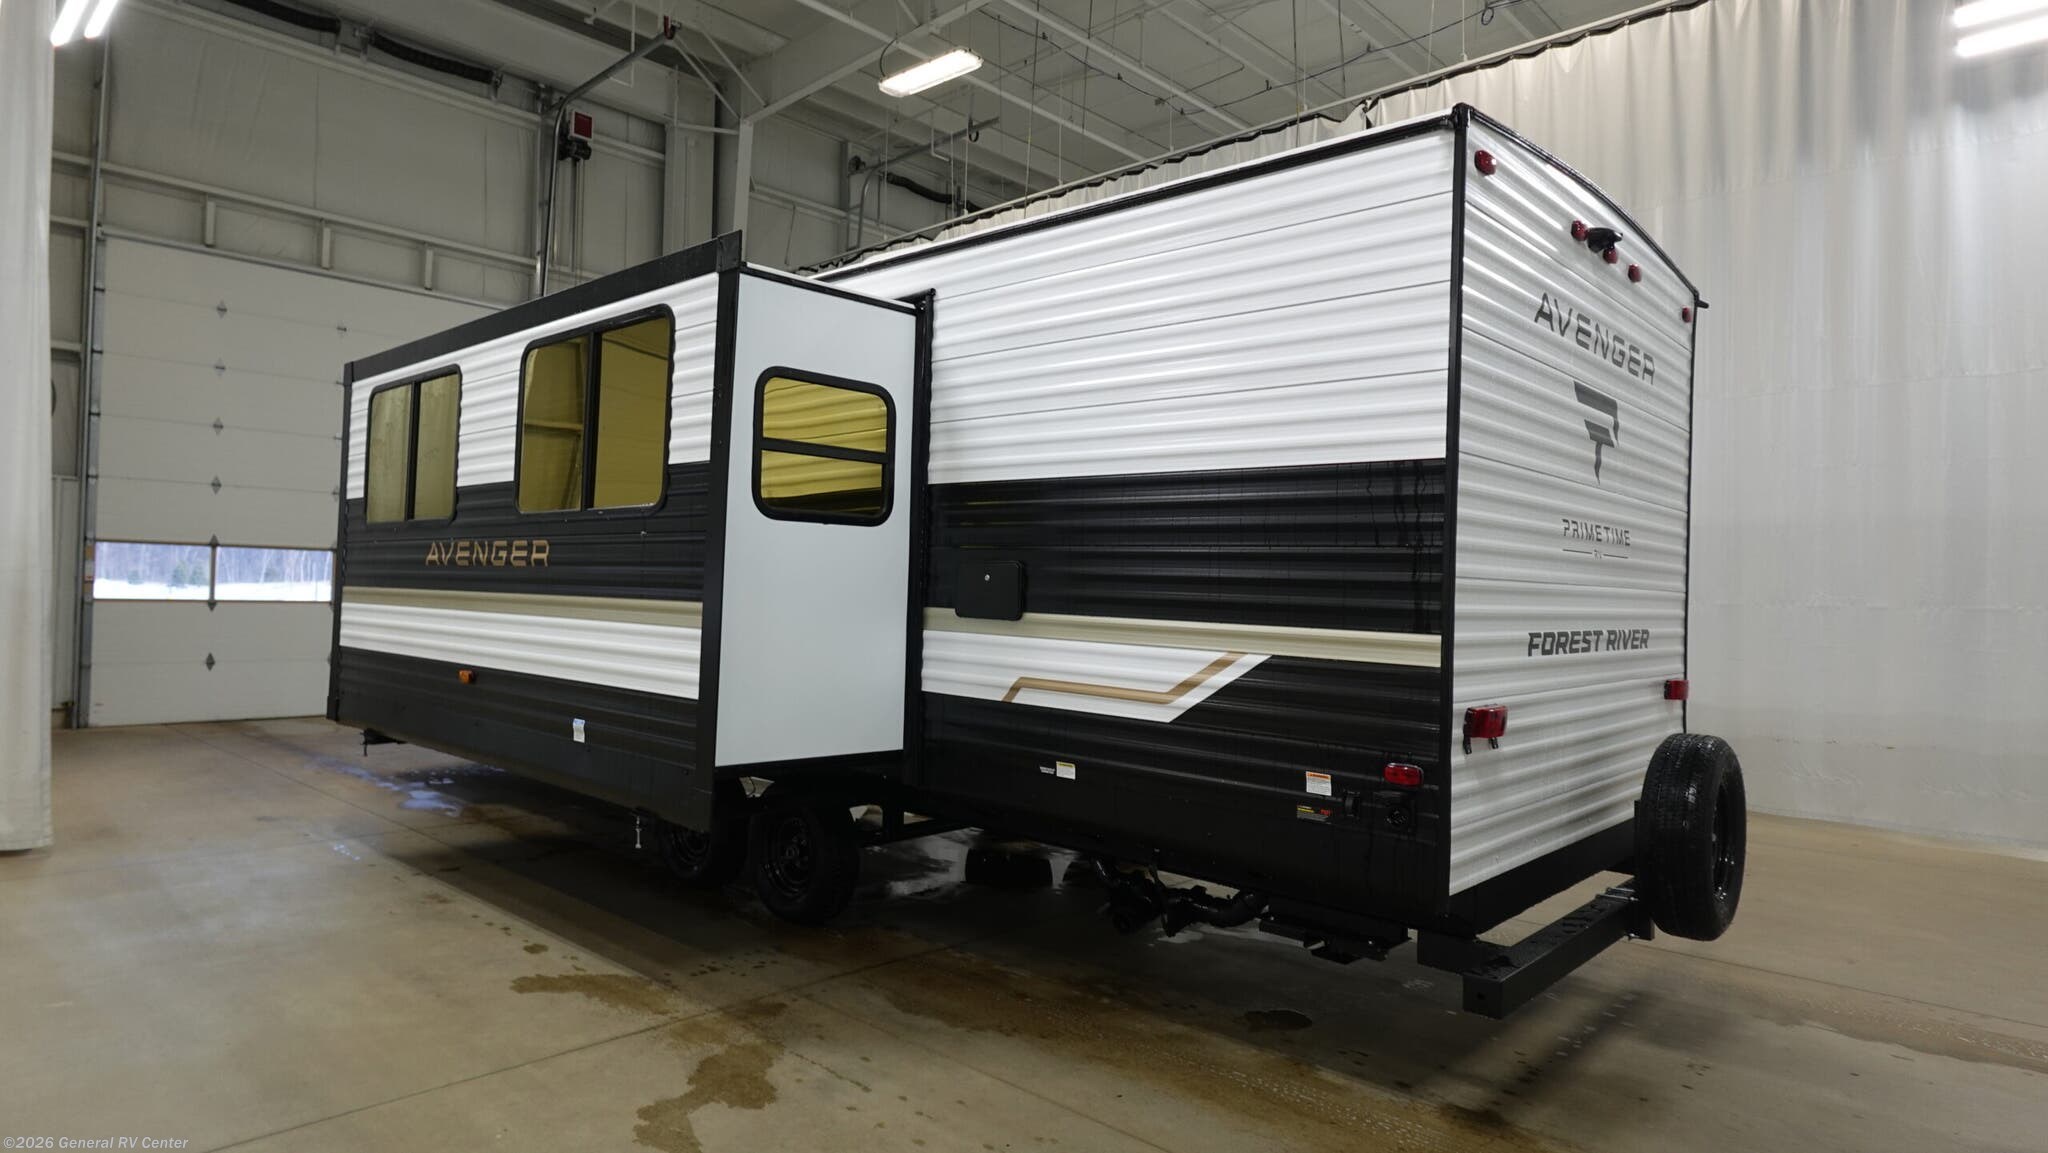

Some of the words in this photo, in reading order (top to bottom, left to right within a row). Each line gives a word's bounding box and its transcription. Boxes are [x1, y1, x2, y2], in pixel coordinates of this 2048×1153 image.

[1534, 292, 1655, 385] AVENGER
[425, 539, 550, 567] AVENGER
[1527, 630, 1604, 657] FOREST
[1606, 629, 1650, 652] RIVER
